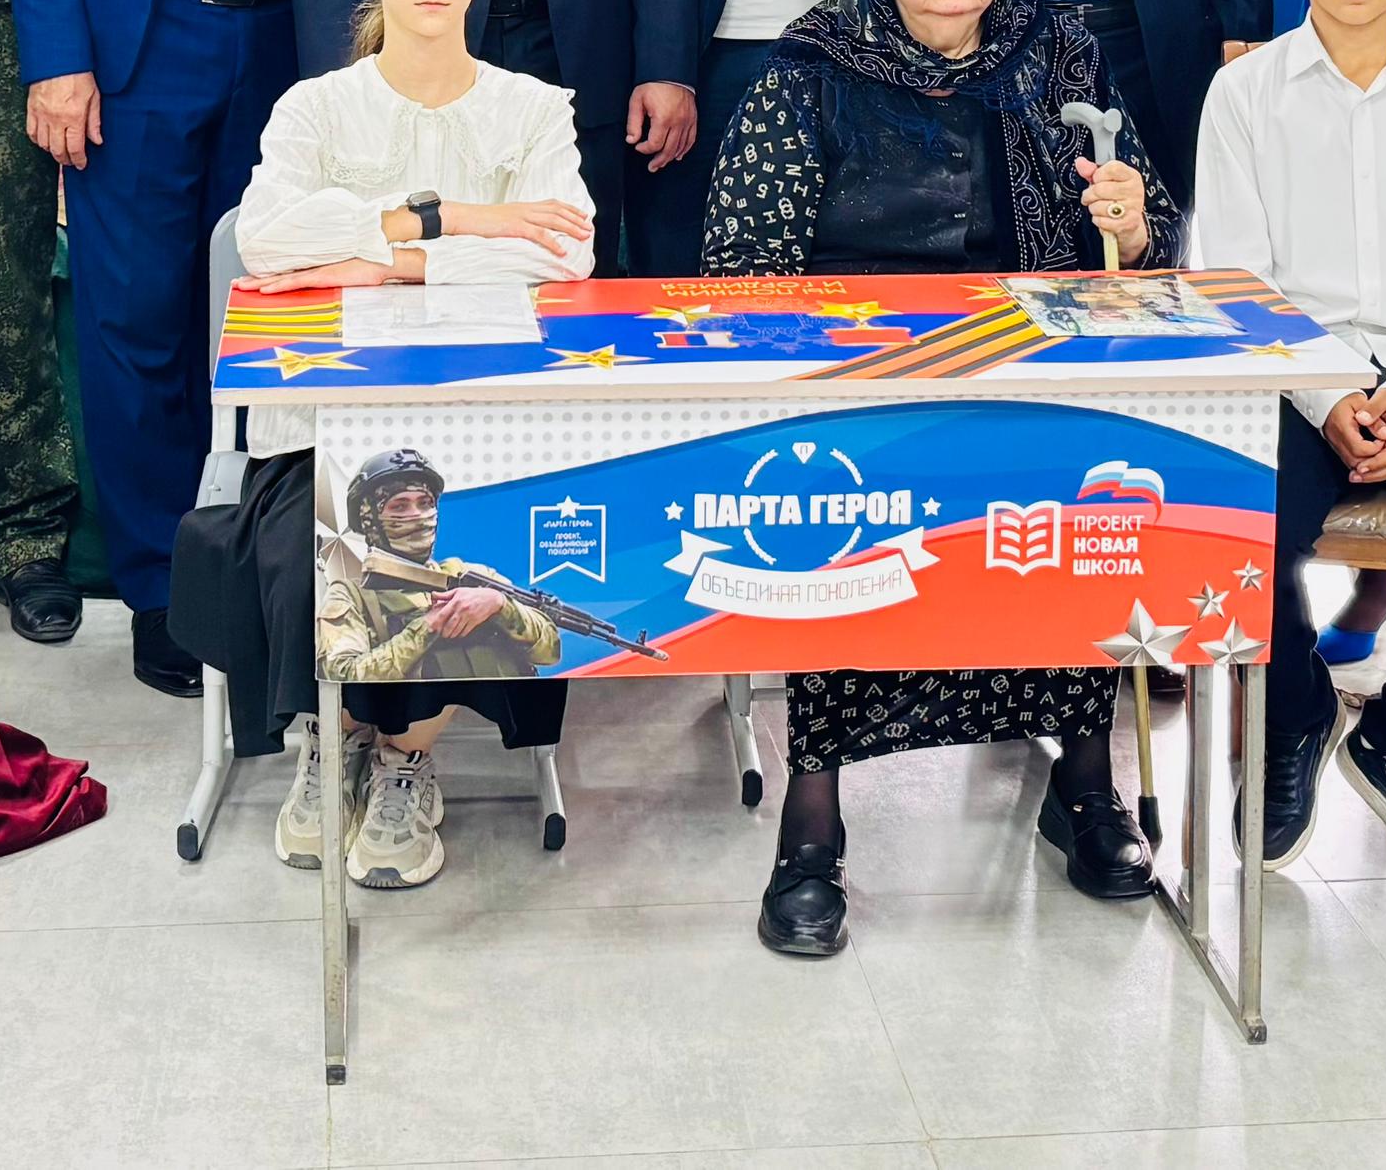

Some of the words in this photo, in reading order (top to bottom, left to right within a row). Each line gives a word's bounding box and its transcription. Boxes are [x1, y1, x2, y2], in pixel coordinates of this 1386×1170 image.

[694, 493, 803, 529] ПАРТА
[809, 489, 912, 525] ГЕРОЯ
[1073, 515, 1145, 532] ПРОЕКТ
[1073, 536, 1138, 554] НОВАЯ
[1072, 558, 1144, 576] ШКОЛА
[806, 568, 903, 604] ПОКОЛЕНИЯ
